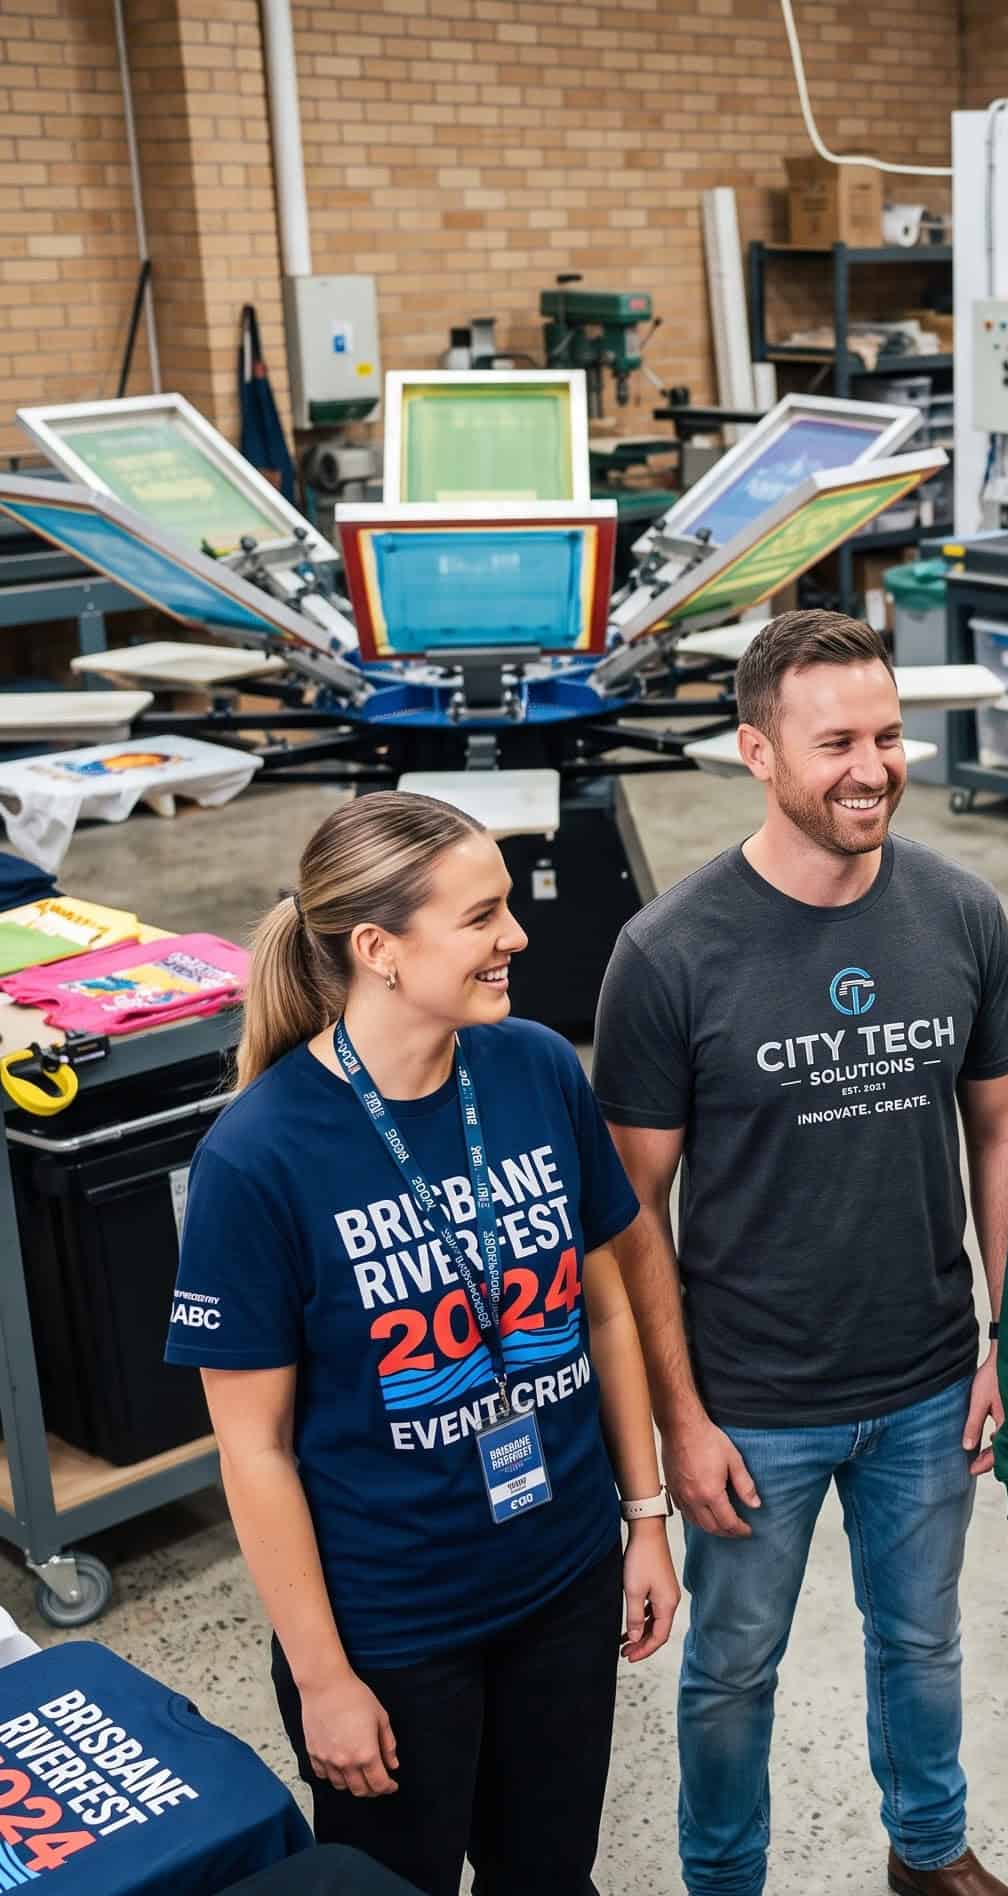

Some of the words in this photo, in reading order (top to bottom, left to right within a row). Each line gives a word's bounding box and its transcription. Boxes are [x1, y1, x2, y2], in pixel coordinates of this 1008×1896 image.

[756, 1029, 846, 1072] CITY
[857, 1016, 956, 1056] TECH
[809, 1057, 915, 1086] SOLUTIONS
[797, 1103, 871, 1126] INNOVATE.
[875, 1094, 931, 1113] CREATE.
[842, 1086, 861, 1096] EST.
[390, 1392, 500, 1451] EVENT
[510, 1352, 591, 1414] CREW
[0, 1712, 148, 1837] RIVERFEST
[37, 1688, 200, 1816] BRISBANE
